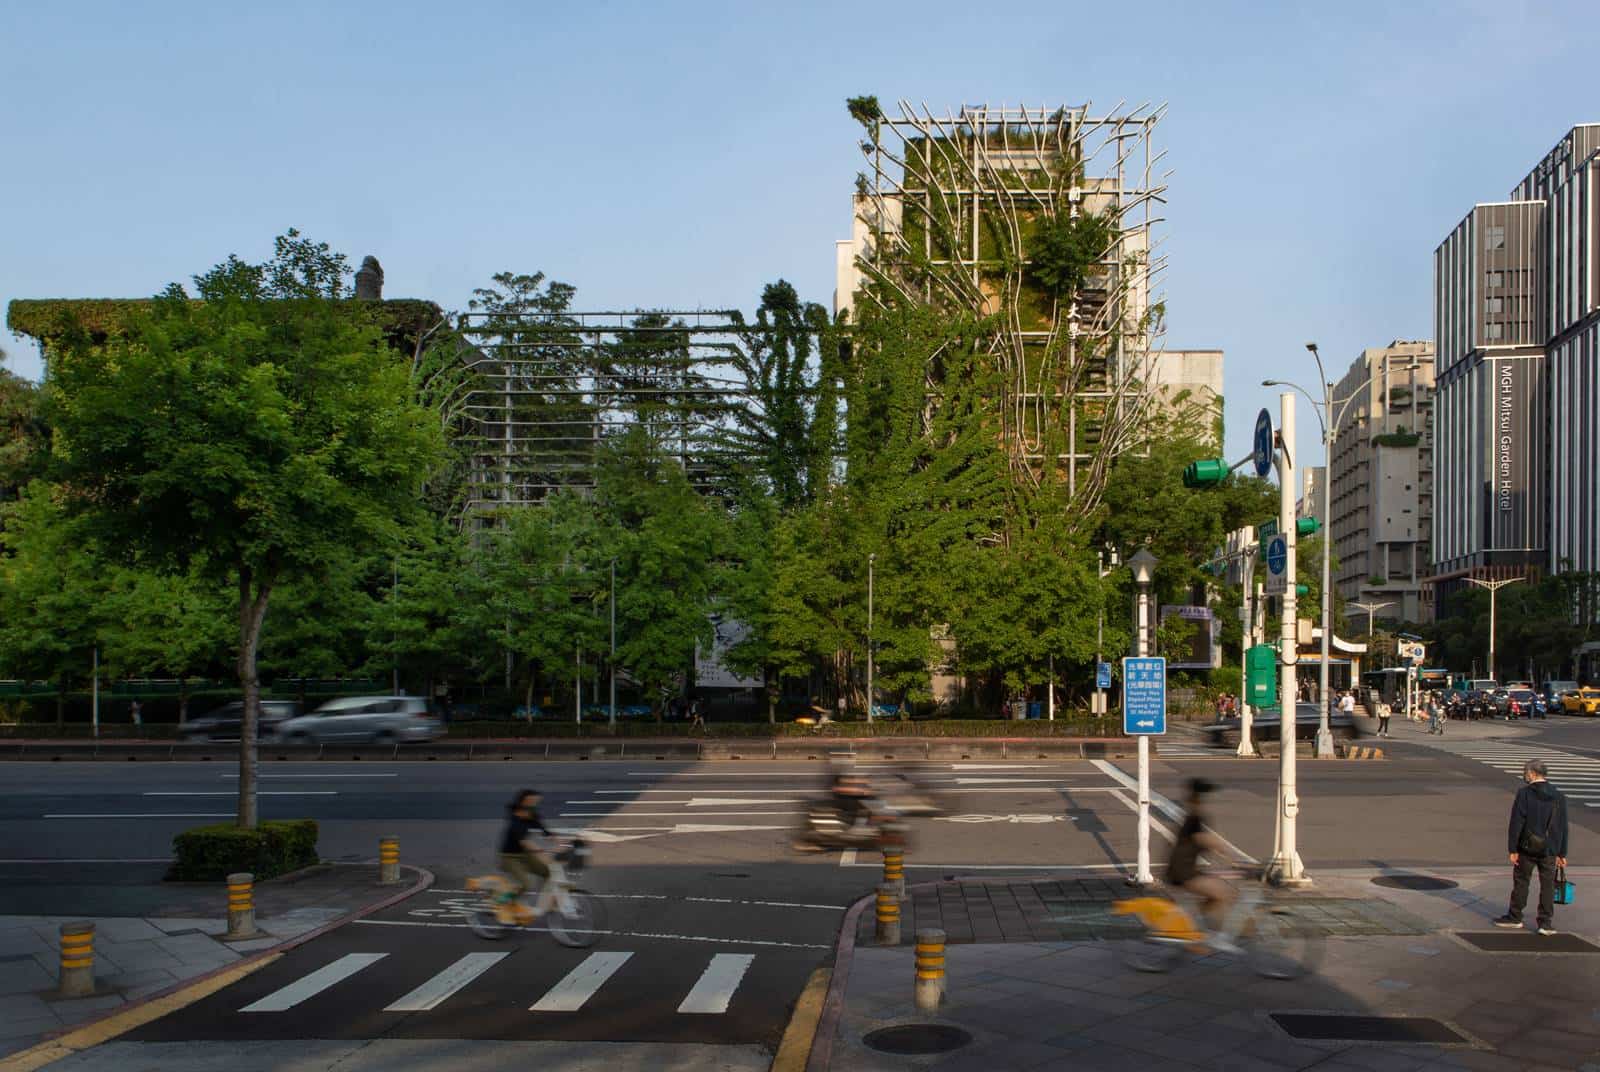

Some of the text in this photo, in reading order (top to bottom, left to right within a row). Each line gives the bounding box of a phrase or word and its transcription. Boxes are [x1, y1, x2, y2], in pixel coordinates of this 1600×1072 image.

[1501, 365, 1513, 511] MGH Mitsui Garden Hotel
